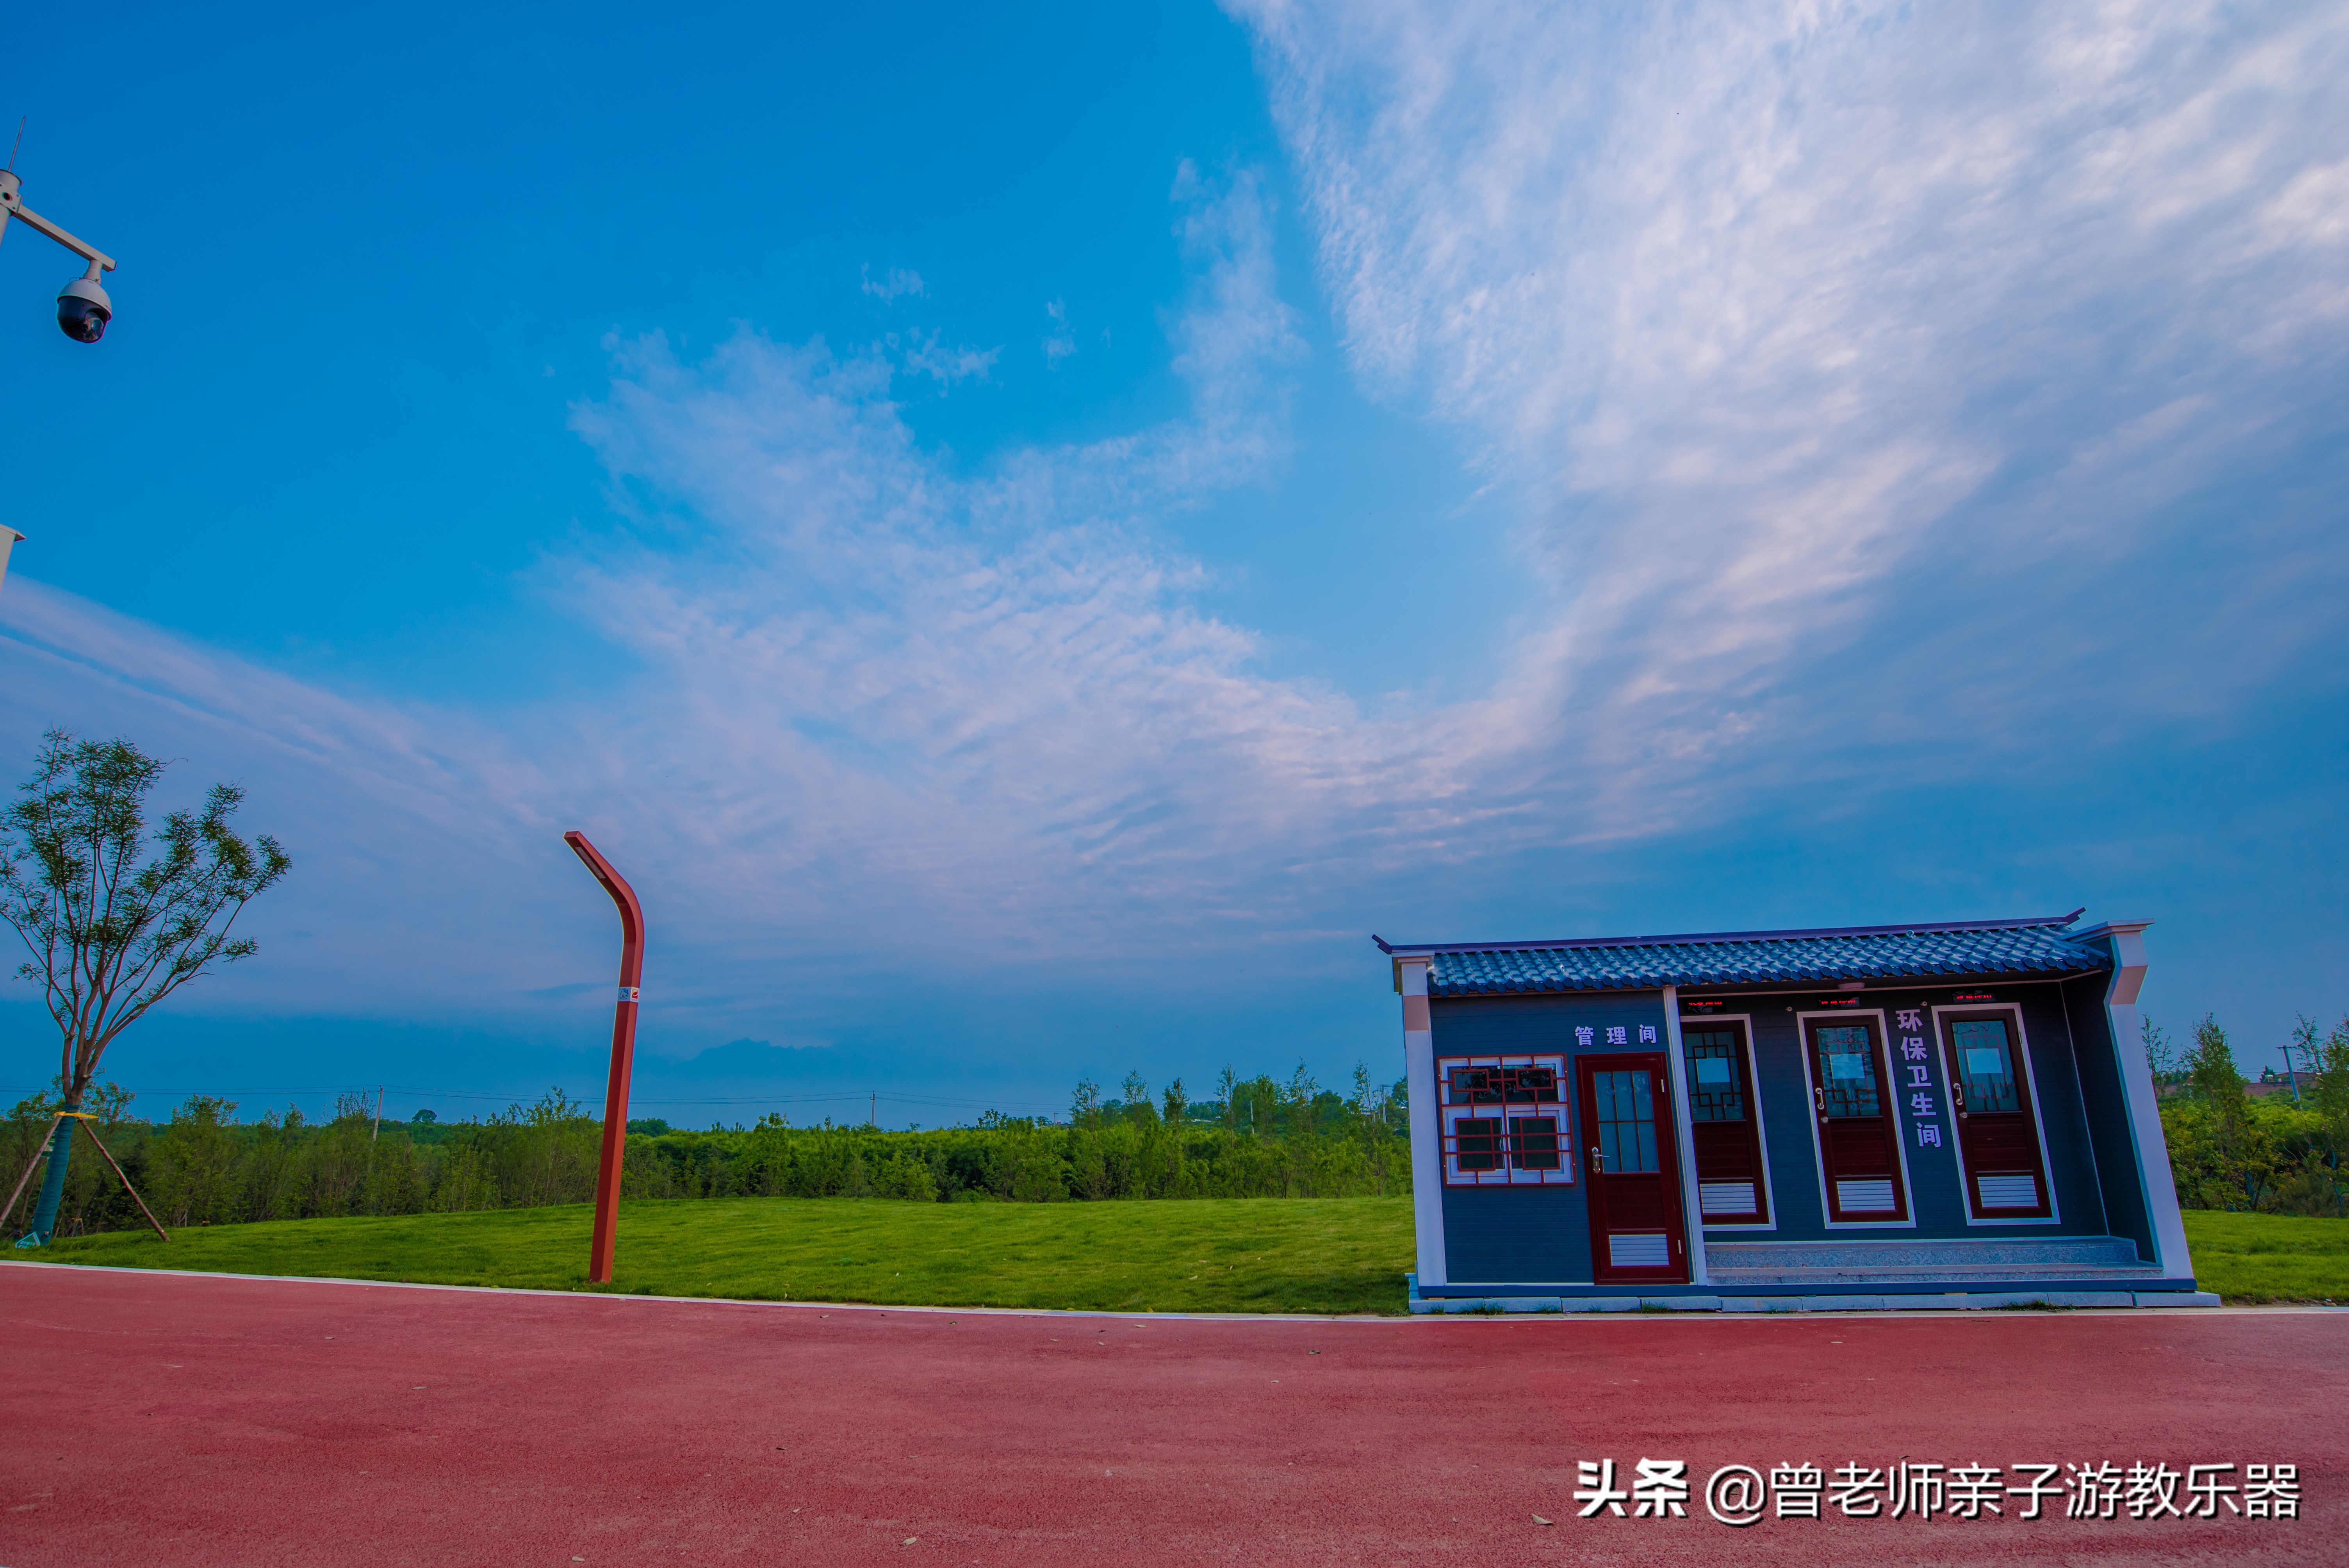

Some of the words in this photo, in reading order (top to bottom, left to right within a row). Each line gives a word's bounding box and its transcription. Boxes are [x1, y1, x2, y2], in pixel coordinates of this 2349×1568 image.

[1575, 1024, 1657, 1046] 管理间
[1895, 1009, 1942, 1148] 环保卫生间
